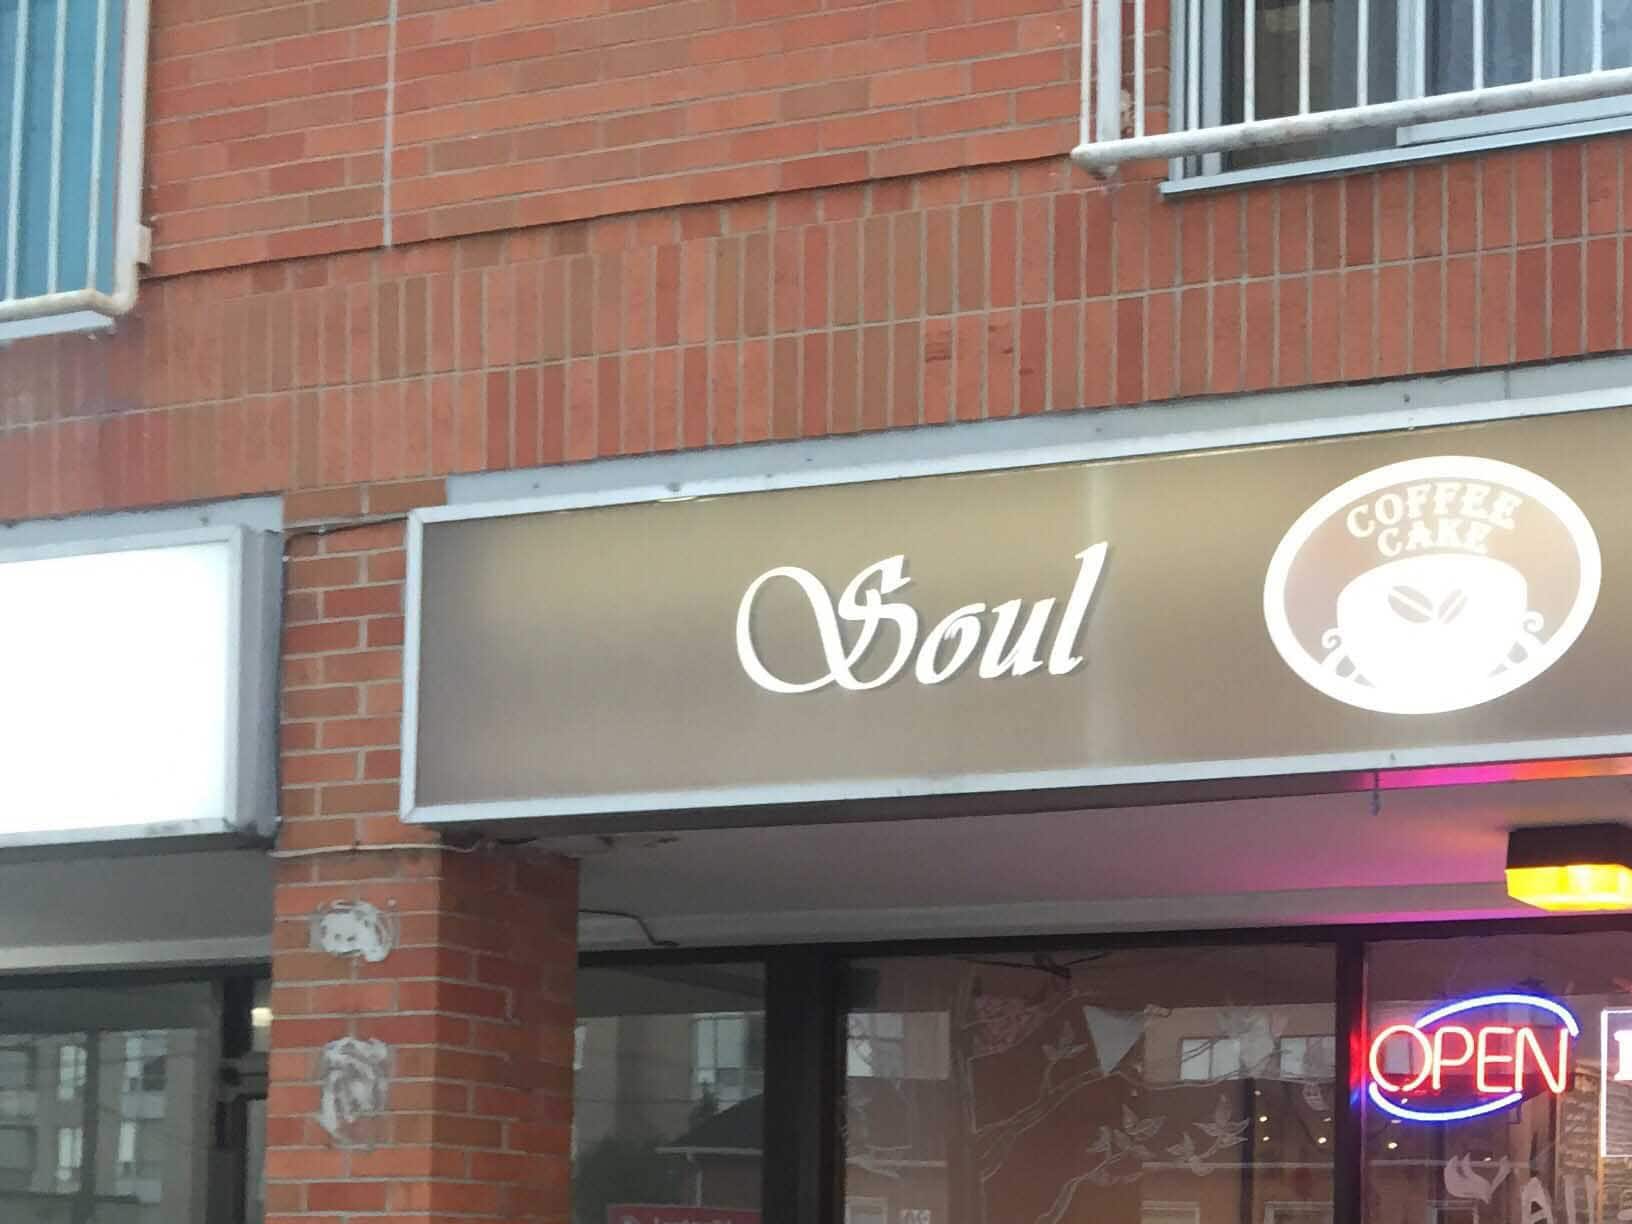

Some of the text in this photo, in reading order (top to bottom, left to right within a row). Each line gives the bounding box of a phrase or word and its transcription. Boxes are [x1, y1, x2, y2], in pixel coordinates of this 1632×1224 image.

[1346, 481, 1524, 539] COFFEE
[1377, 517, 1493, 558] CAKE
[735, 540, 1109, 695] Soul
[1368, 1024, 1570, 1095] OPEN
